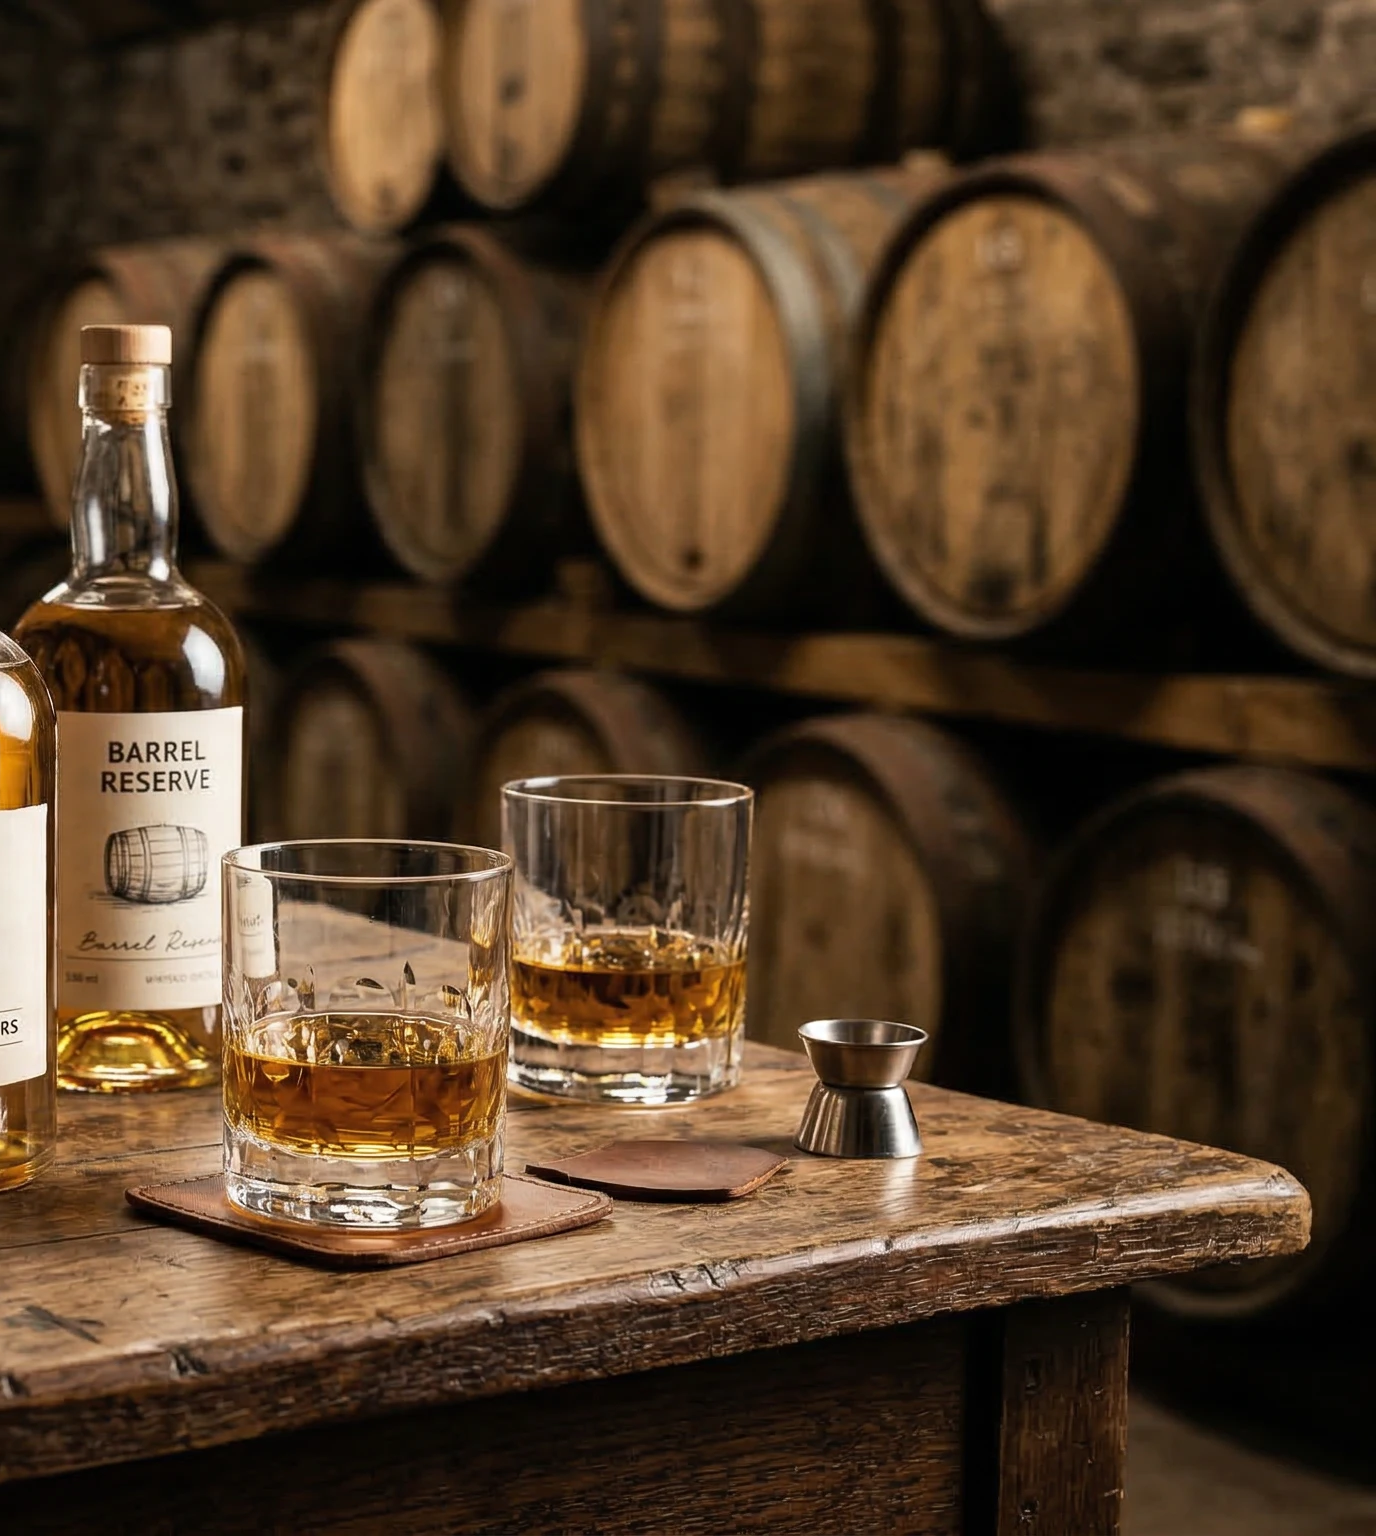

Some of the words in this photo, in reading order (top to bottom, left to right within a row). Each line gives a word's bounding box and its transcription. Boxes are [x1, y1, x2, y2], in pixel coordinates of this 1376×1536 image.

[109, 741, 205, 763] BARREL
[102, 769, 209, 793] RESERVE
[79, 931, 155, 951] Barrel
